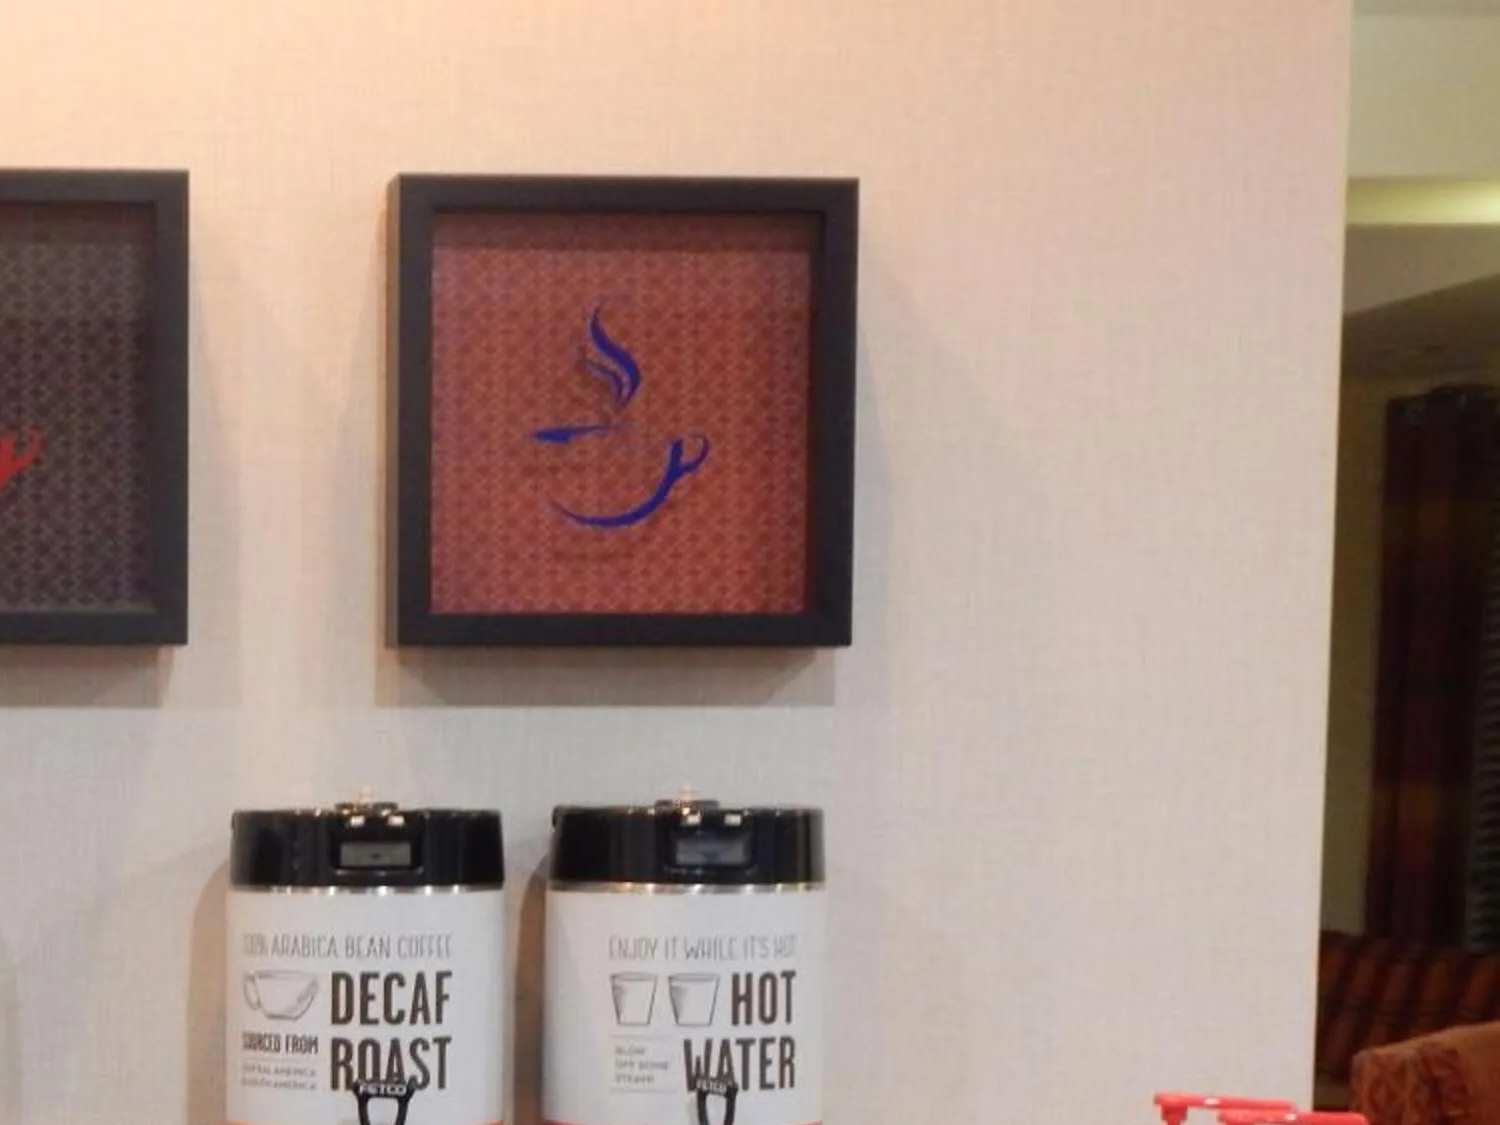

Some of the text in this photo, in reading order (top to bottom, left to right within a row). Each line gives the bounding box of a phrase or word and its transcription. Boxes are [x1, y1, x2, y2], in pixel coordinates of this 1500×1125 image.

[271, 933, 338, 959] ARABICA
[345, 934, 391, 960] BEAN
[397, 933, 453, 960] COFFEE
[608, 935, 658, 961] ENJOY
[664, 936, 678, 961] IT
[683, 935, 736, 961] WHILE
[331, 970, 453, 1026] DECAF
[731, 969, 797, 1027] HOT
[285, 1033, 319, 1055] FROM
[330, 1036, 452, 1091] ROAST
[683, 1035, 797, 1092] WATER
